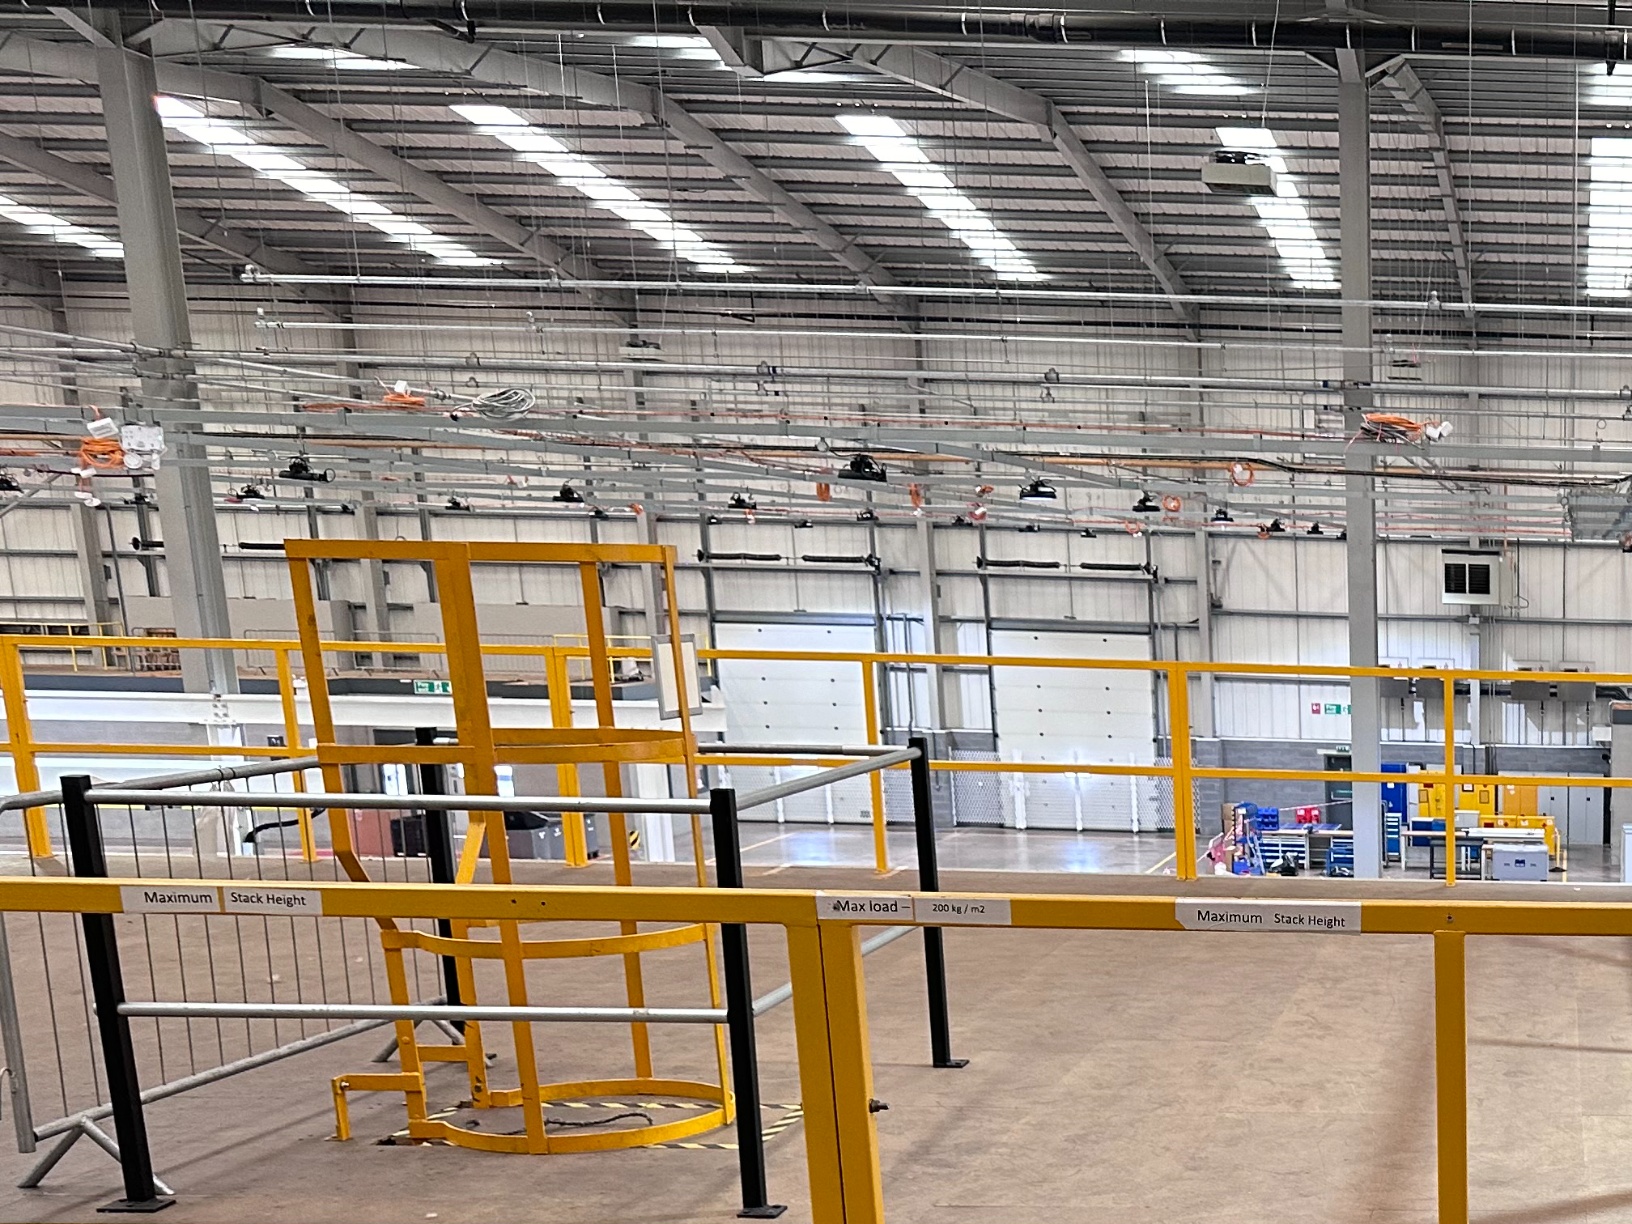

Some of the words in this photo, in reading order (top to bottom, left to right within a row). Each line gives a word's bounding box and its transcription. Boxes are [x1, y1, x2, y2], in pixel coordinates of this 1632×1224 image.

[144, 891, 213, 904] Maximum
[230, 892, 263, 904] Stack
[266, 893, 307, 908] Height
[837, 900, 866, 912] Max
[869, 900, 898, 913] load
[932, 903, 950, 913] 200
[951, 903, 962, 915] kg
[971, 905, 985, 914] m2
[1197, 909, 1263, 924] Maximum
[1274, 912, 1305, 925] Stack
[1308, 915, 1346, 929] Height
